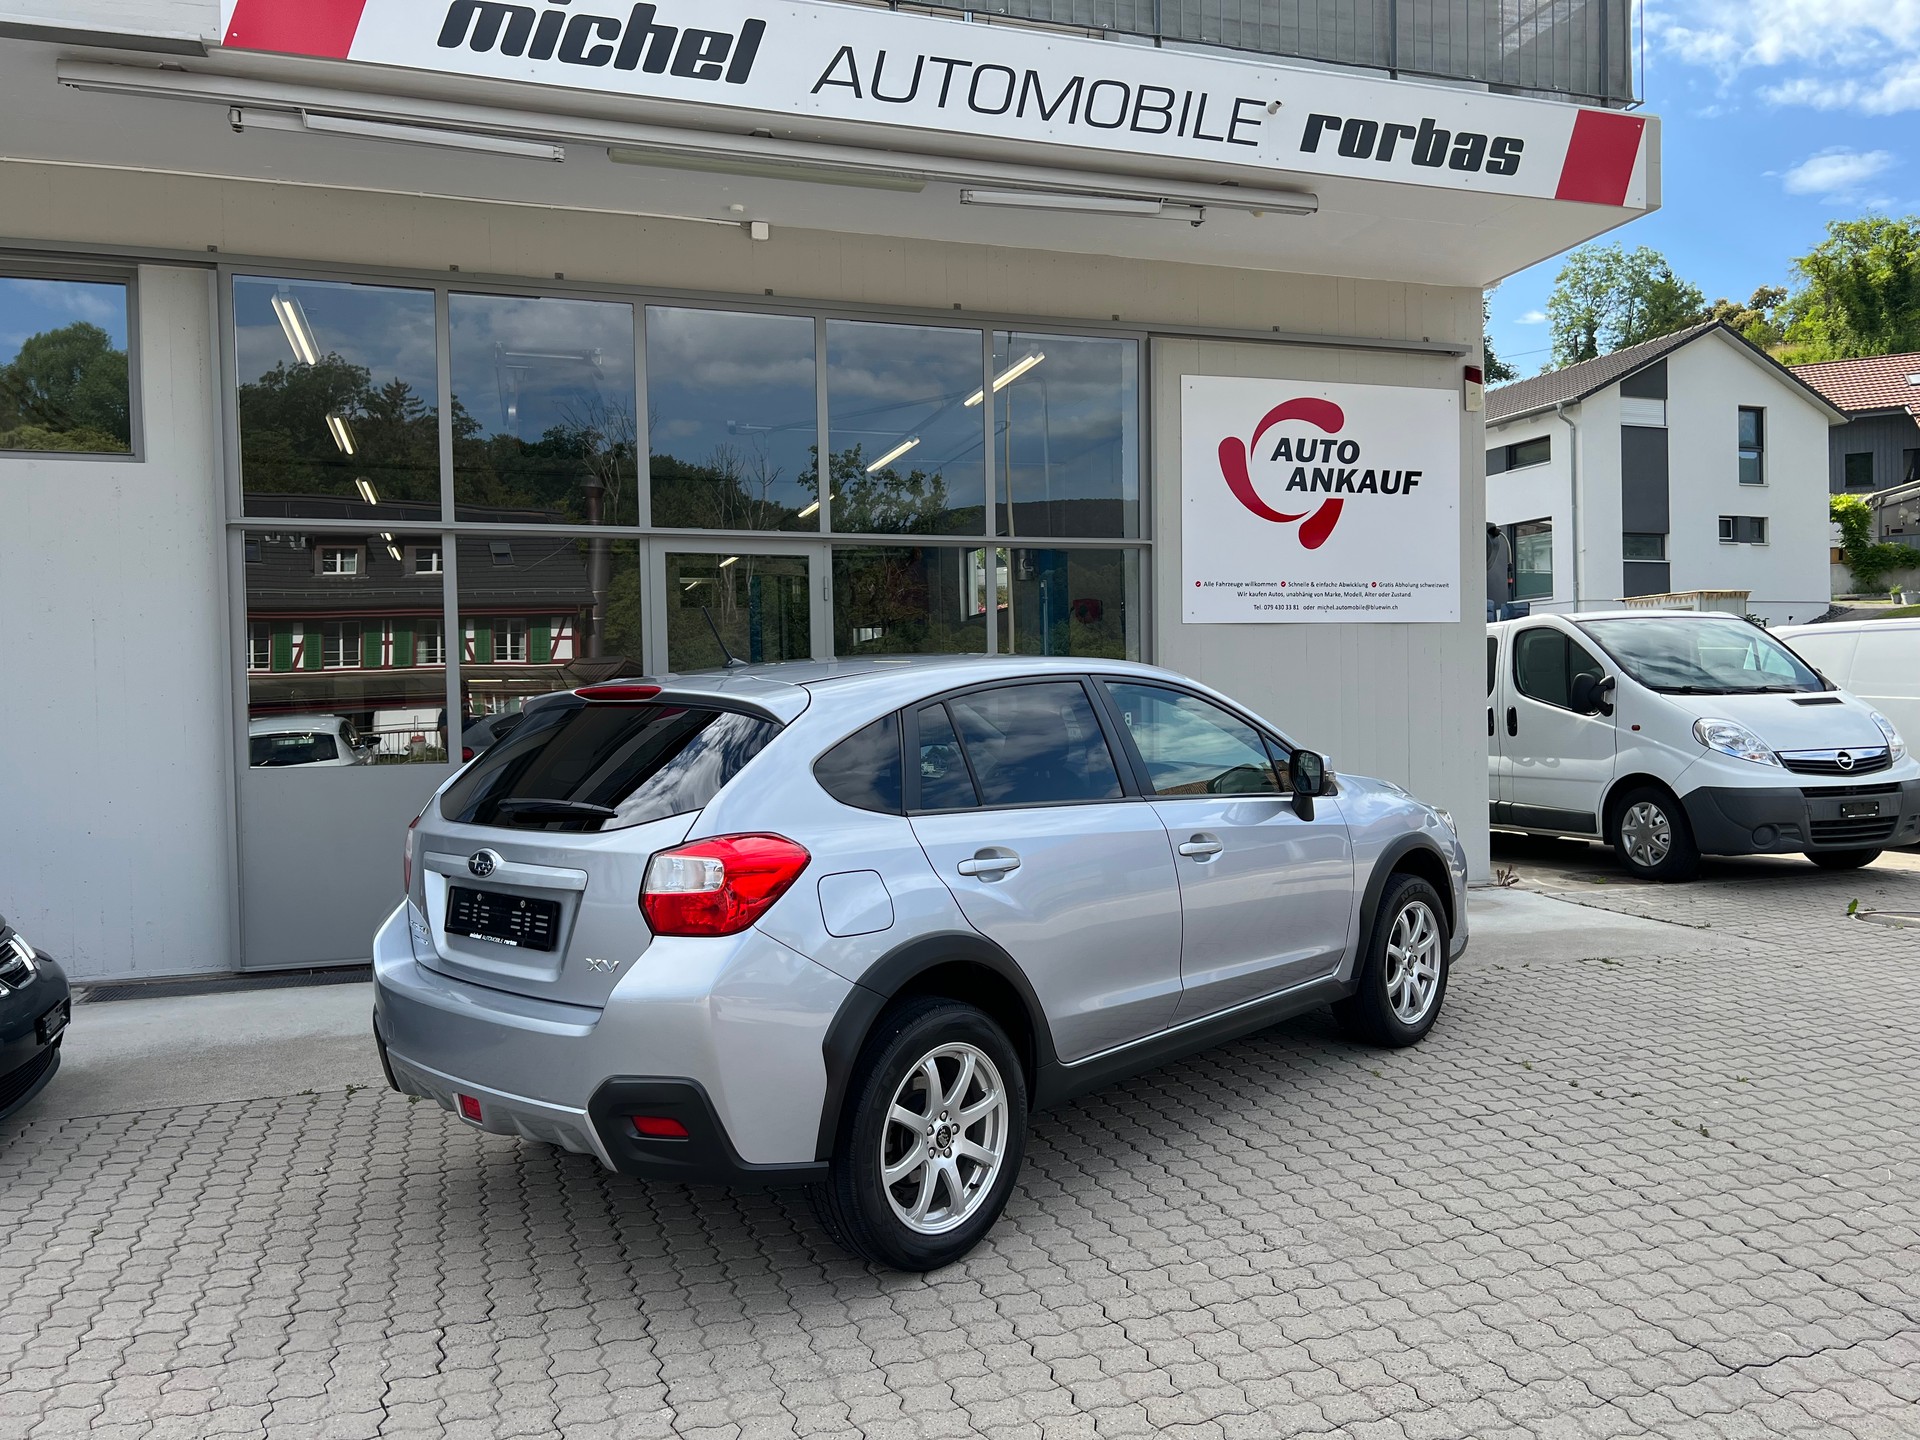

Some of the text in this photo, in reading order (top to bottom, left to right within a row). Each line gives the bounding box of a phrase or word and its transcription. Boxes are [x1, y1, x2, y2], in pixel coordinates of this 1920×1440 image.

[437, 0, 1525, 176] michel AUTOMOBILE rorbas
[1270, 437, 1360, 464] AUTO
[1285, 467, 1423, 495] ANKAUF
[1215, 581, 1244, 589] Fahrzeuge
[1338, 581, 1369, 589] Abwicklung
[1317, 604, 1399, 612] michel.automobile@bluewin.ch
[585, 957, 620, 974] XV
